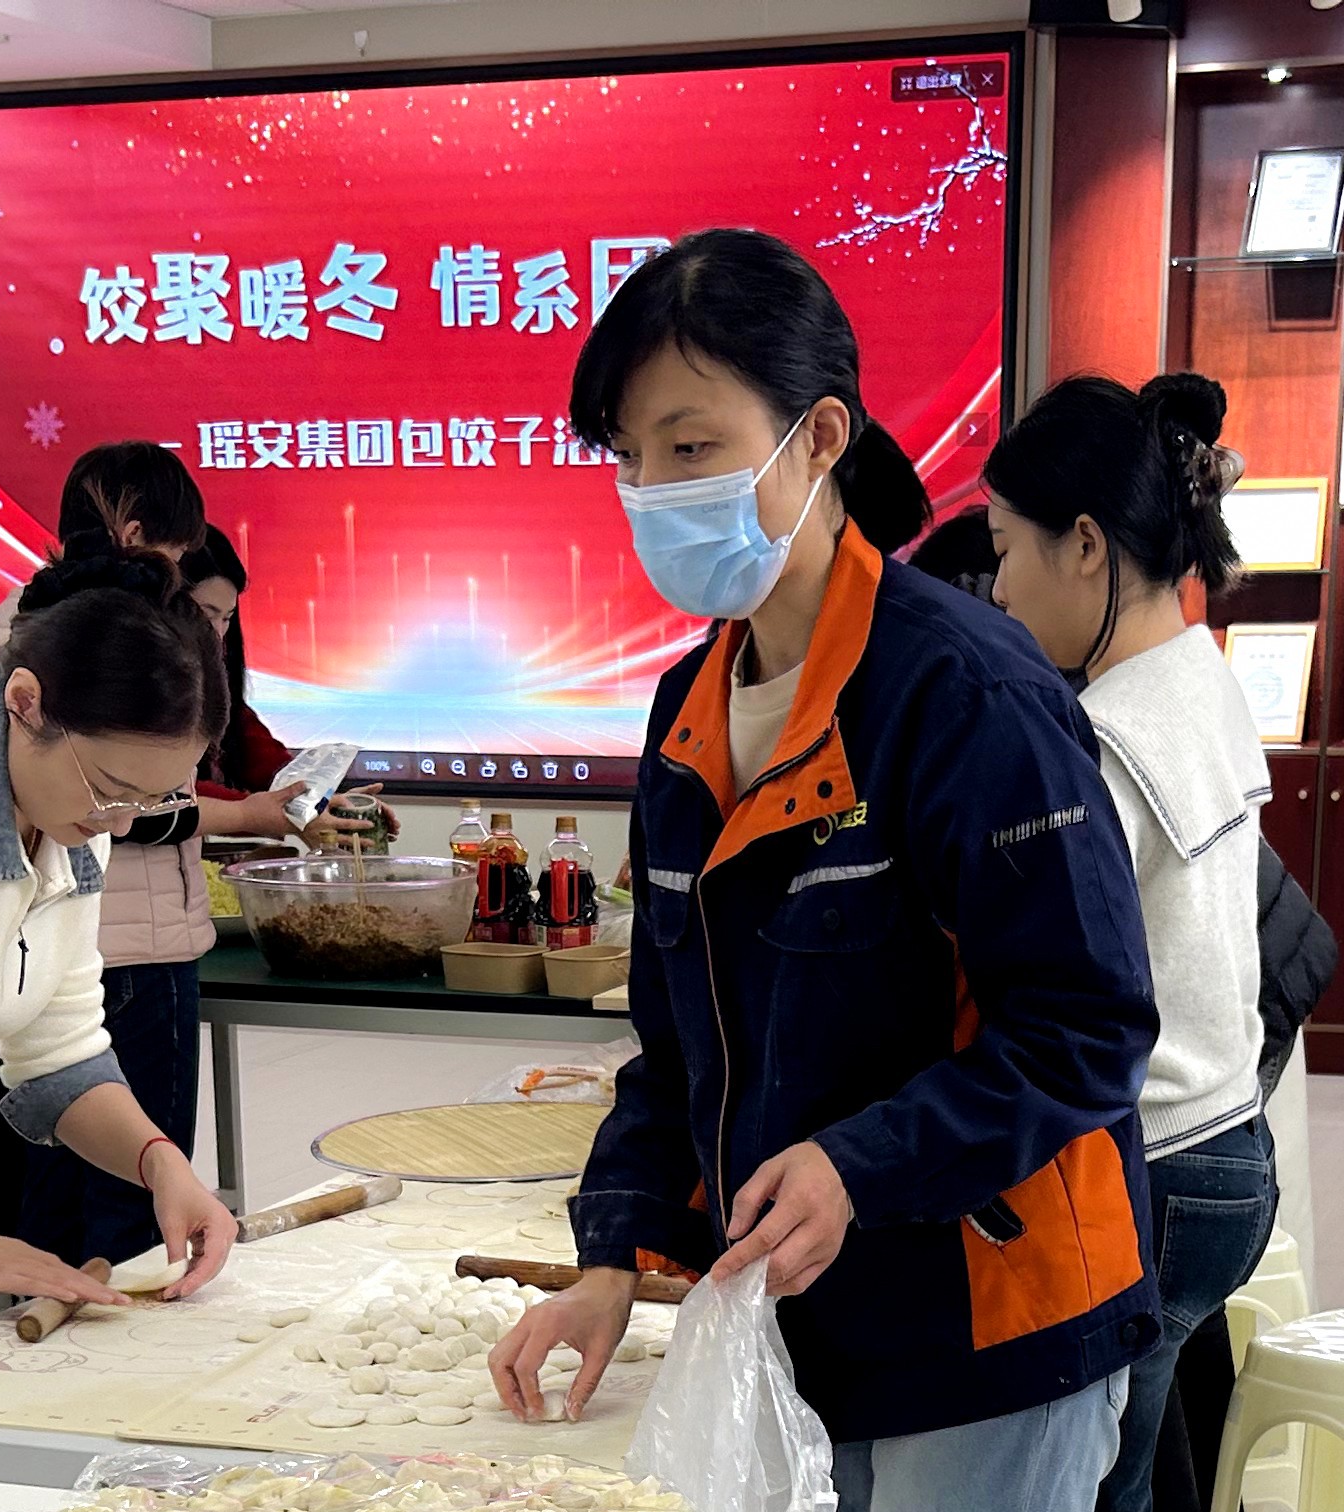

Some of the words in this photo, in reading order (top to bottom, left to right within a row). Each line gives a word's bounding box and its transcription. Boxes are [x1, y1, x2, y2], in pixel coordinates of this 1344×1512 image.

[79, 243, 398, 346] 饺聚暖冬
[197, 417, 620, 469] 瑶安集团包饺子活
[364, 759, 391, 772] 100%
